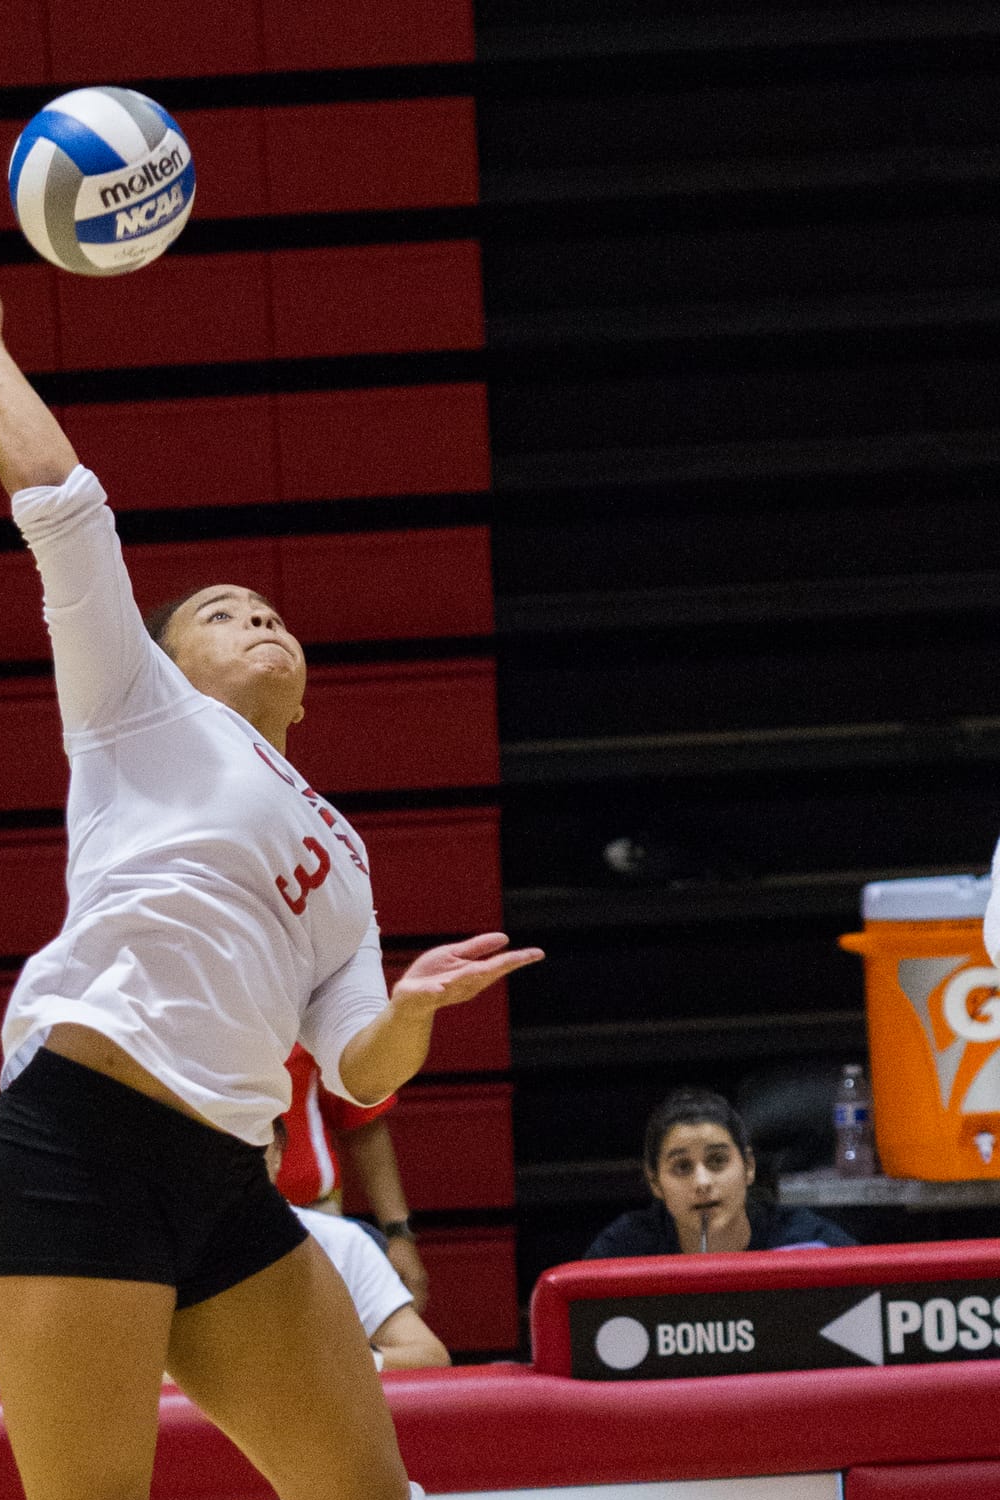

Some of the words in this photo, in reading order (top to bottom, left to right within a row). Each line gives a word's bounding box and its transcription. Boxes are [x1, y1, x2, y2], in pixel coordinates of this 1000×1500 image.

[99, 146, 184, 209] molten
[115, 183, 184, 241] NCAA
[274, 836, 331, 916] 3
[656, 1319, 756, 1357] BONUS
